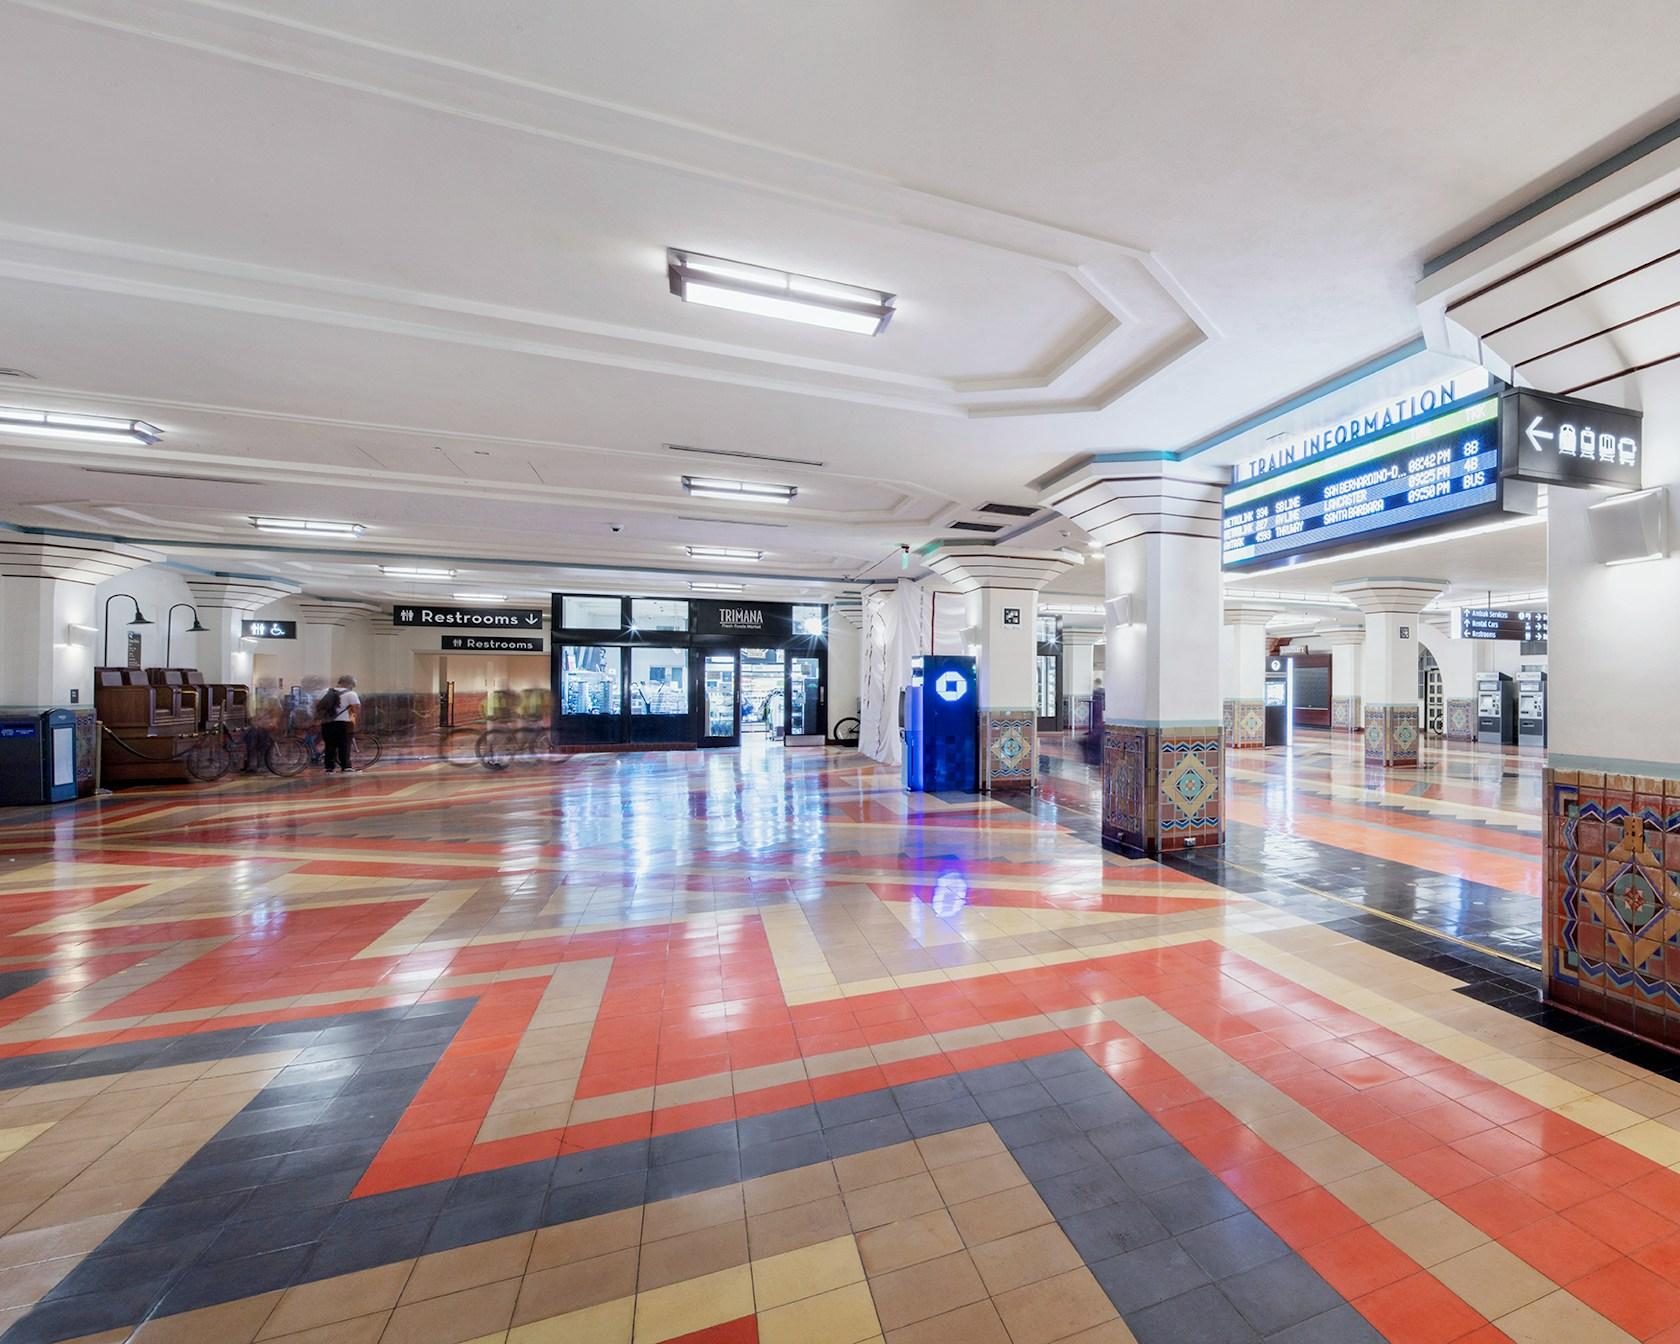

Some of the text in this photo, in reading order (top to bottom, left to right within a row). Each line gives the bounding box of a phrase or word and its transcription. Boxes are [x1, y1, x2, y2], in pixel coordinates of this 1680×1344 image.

[1249, 445, 1295, 478] TRAIN
[1303, 380, 1455, 457] INFORMATION
[1285, 496, 1301, 512] LINE
[1324, 484, 1339, 498] SAN
[1437, 448, 1451, 464] PM
[1464, 440, 1479, 456] 8B
[1324, 489, 1367, 511] LANCASTER
[1437, 463, 1451, 480] PM
[1464, 456, 1478, 471] 4B
[1323, 509, 1347, 525] SANTA
[1348, 499, 1384, 518] BARBARA
[1436, 479, 1450, 496] PM
[1463, 471, 1485, 489] BUS
[421, 610, 518, 625] Restrooms
[719, 608, 763, 623] TRIMANA
[1488, 621, 1499, 629] Cars
[467, 639, 533, 649] Restrooms
